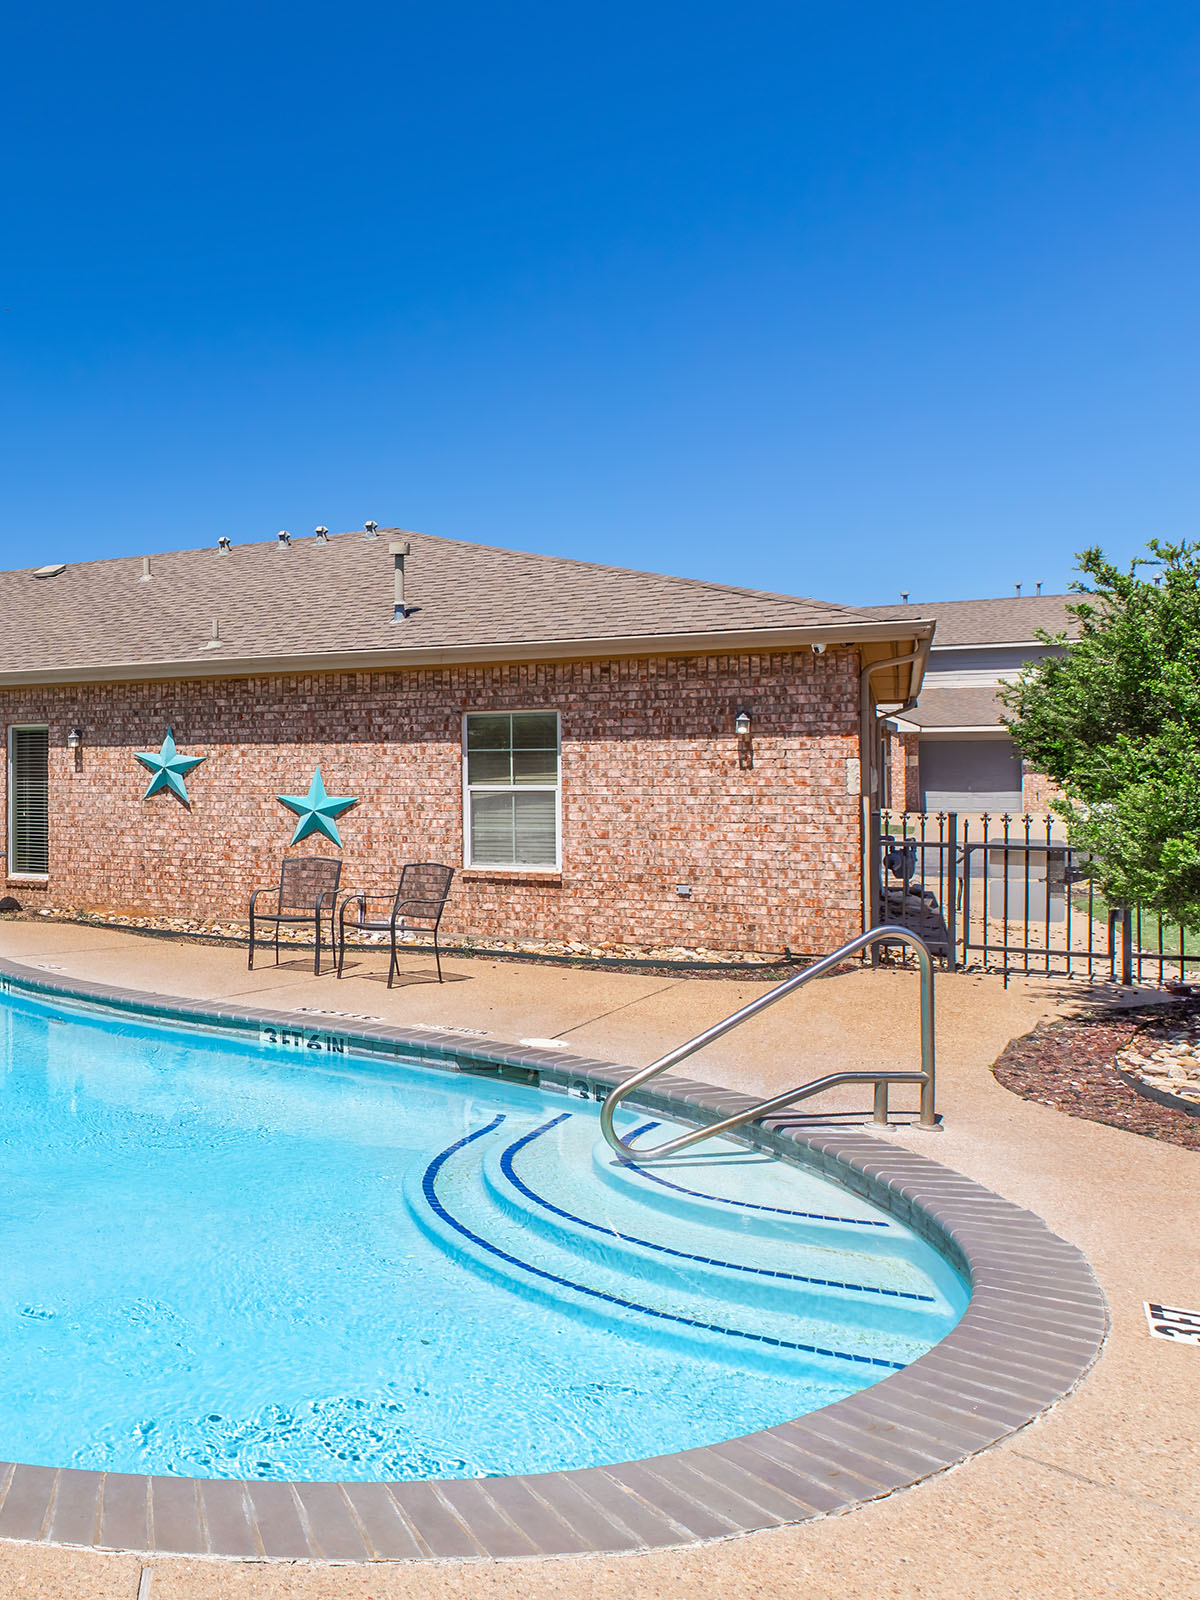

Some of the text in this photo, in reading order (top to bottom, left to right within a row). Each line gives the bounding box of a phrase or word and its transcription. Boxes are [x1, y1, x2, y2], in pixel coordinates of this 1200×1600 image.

[263, 1027, 345, 1054] 3 FT 6 IN
[572, 1079, 590, 1100] 3
[1153, 1324, 1200, 1343] 3
